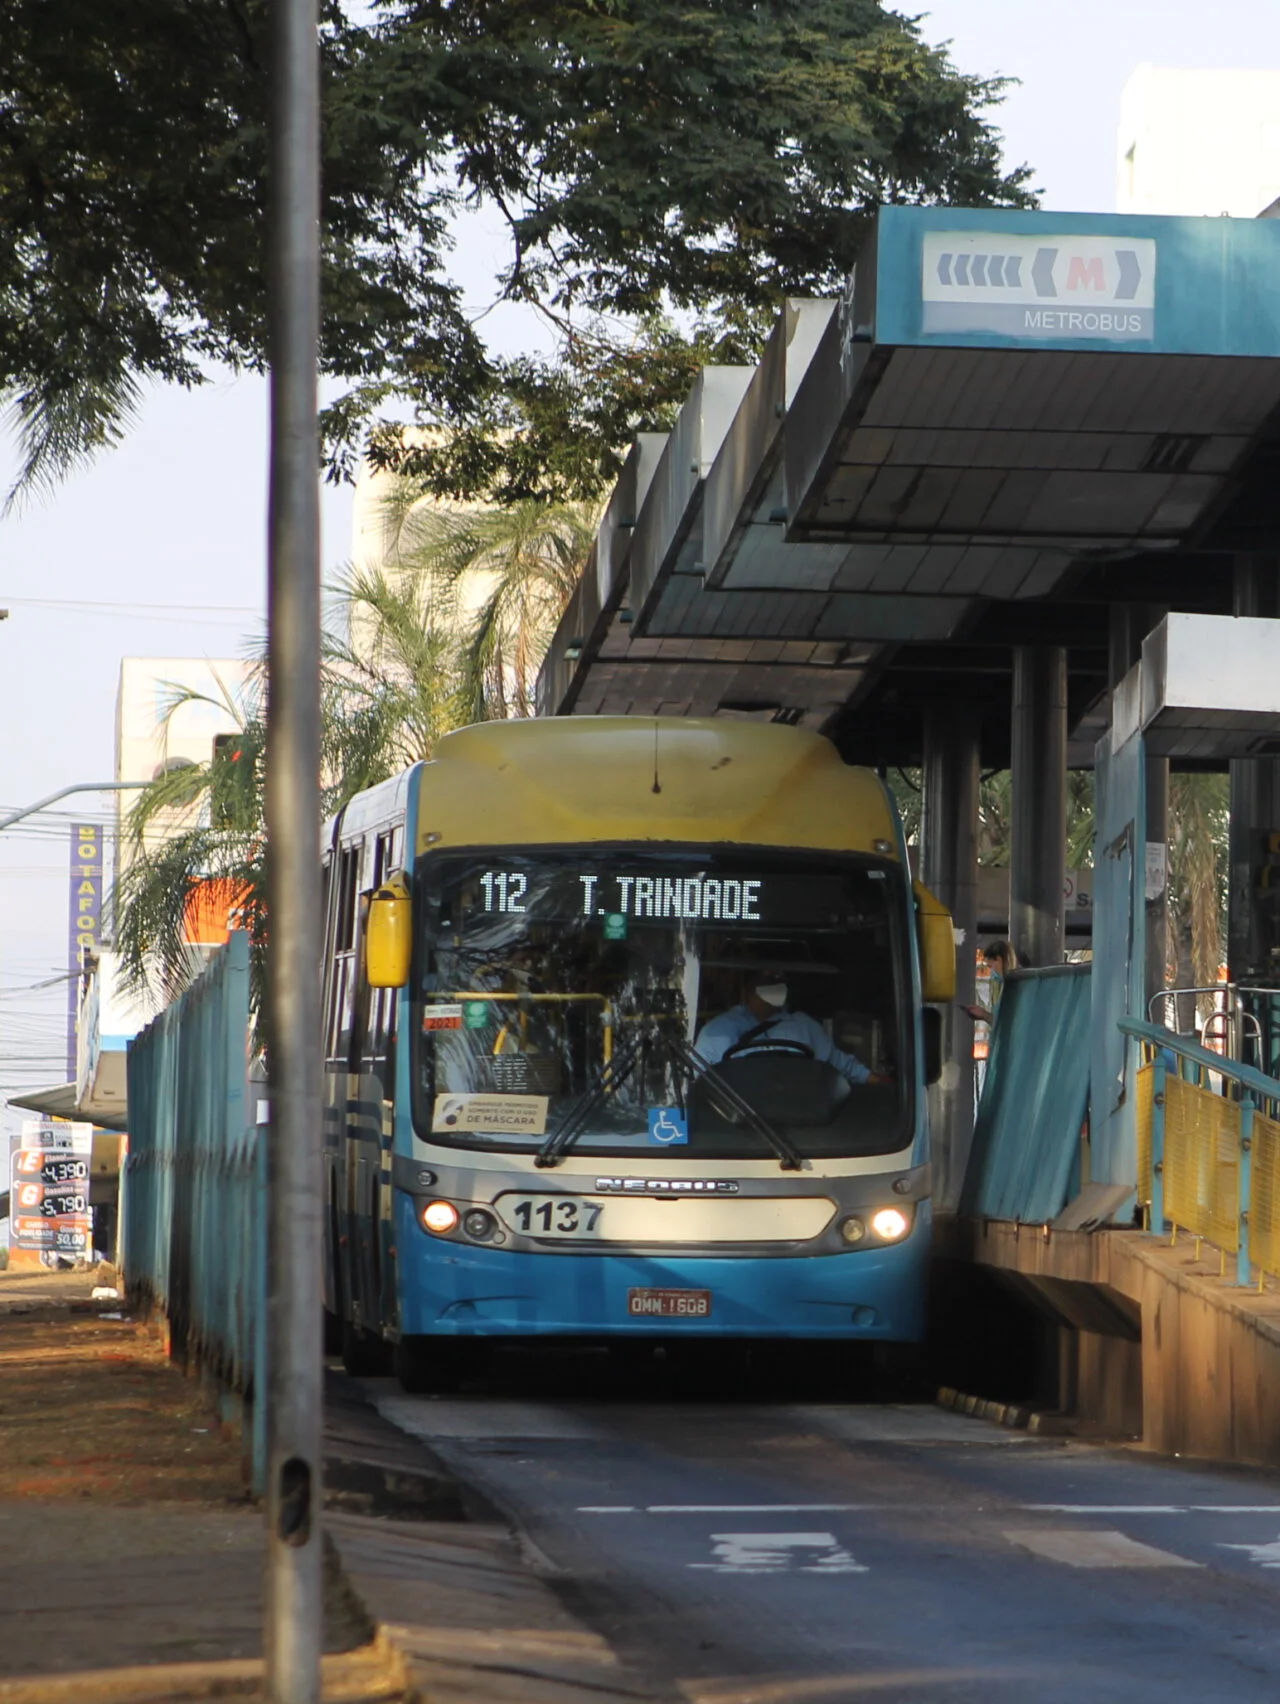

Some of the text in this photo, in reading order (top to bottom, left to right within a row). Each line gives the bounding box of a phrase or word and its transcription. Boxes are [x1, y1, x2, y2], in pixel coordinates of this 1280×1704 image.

[1066, 257, 1106, 291] M
[1024, 311, 1142, 332] METROBUS
[76, 826, 96, 963] BOTAFOG
[480, 872, 761, 920] 112 T. TRINDADE
[466, 1114, 536, 1125] DE MÁSCARA
[22, 1152, 40, 1171] E
[45, 1161, 87, 1180] 4,390
[20, 1184, 38, 1205] G
[595, 1178, 740, 1194] NEOBUS
[44, 1195, 85, 1215] 5,790
[514, 1201, 605, 1232] 1137
[56, 1233, 86, 1246] 50,00
